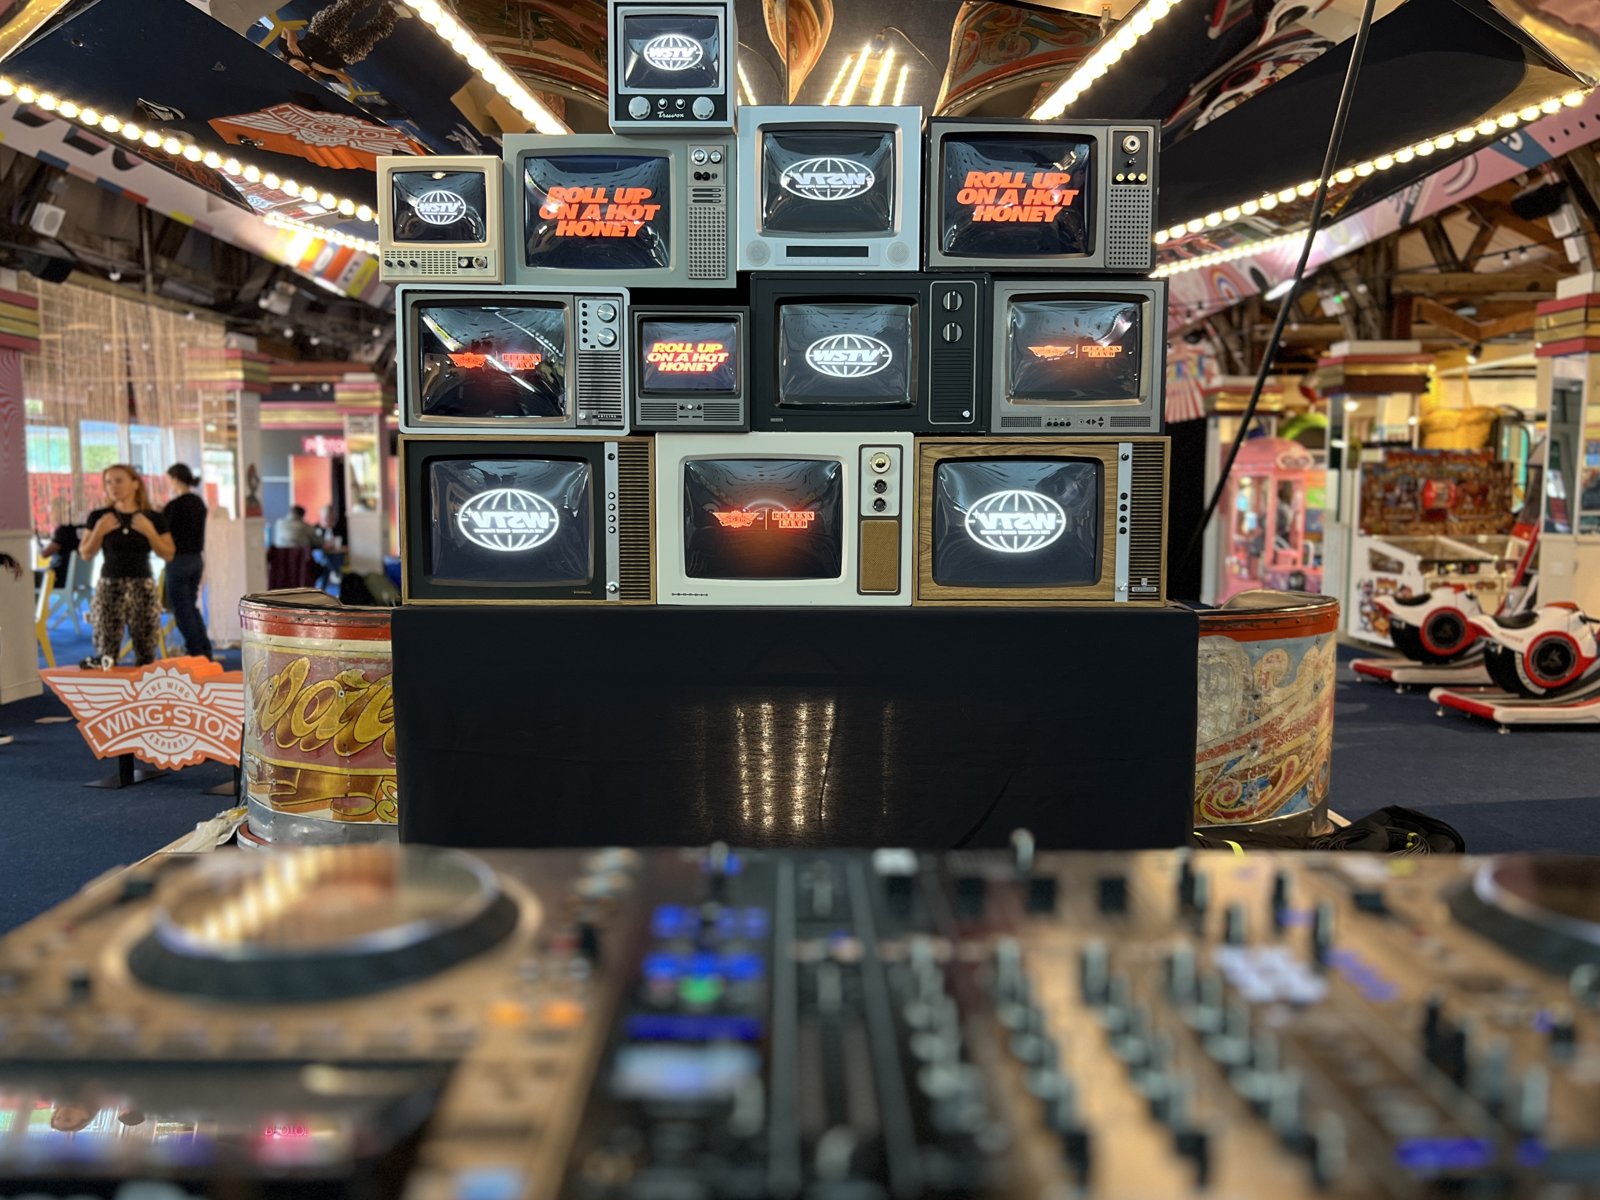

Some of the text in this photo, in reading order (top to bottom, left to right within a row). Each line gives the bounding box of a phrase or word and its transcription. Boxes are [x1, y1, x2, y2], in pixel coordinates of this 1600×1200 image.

[964, 172, 1071, 188] ROLL UP
[546, 186, 652, 203] ROLL UP
[956, 188, 1079, 206] ON A HOT
[539, 204, 661, 220] ON A HOT
[972, 206, 1063, 222] HONEY
[555, 220, 645, 237] HONEY
[652, 343, 723, 353] ROLL UP
[813, 349, 879, 362] WSTV
[647, 353, 729, 362] ON A HOT
[658, 362, 718, 372] HONEY
